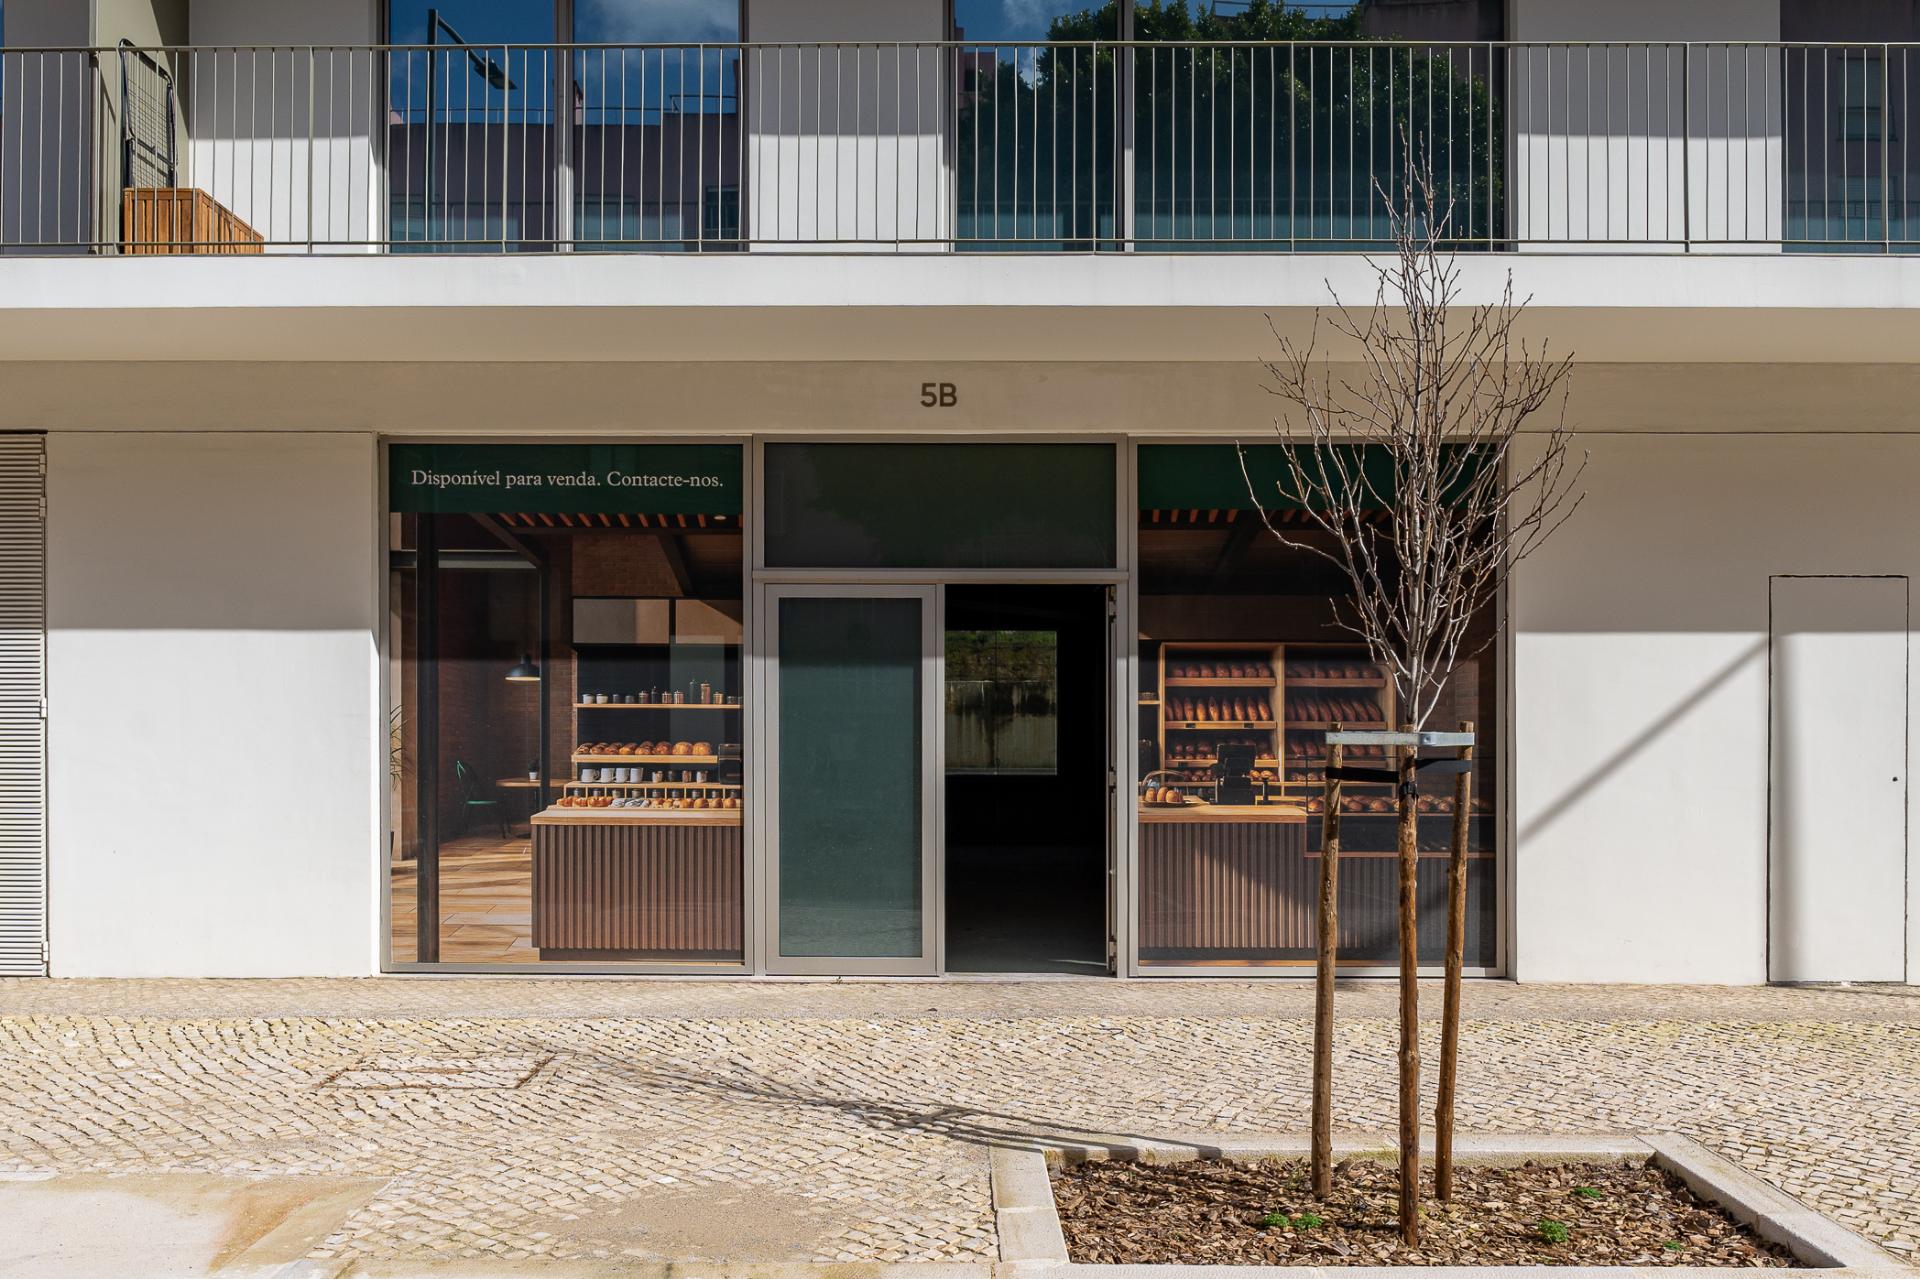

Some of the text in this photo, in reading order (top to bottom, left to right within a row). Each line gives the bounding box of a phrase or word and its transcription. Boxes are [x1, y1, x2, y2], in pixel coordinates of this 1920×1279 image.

[920, 382, 958, 408] 5B
[411, 469, 724, 489] Disponível para venda. Contacte-nos.
